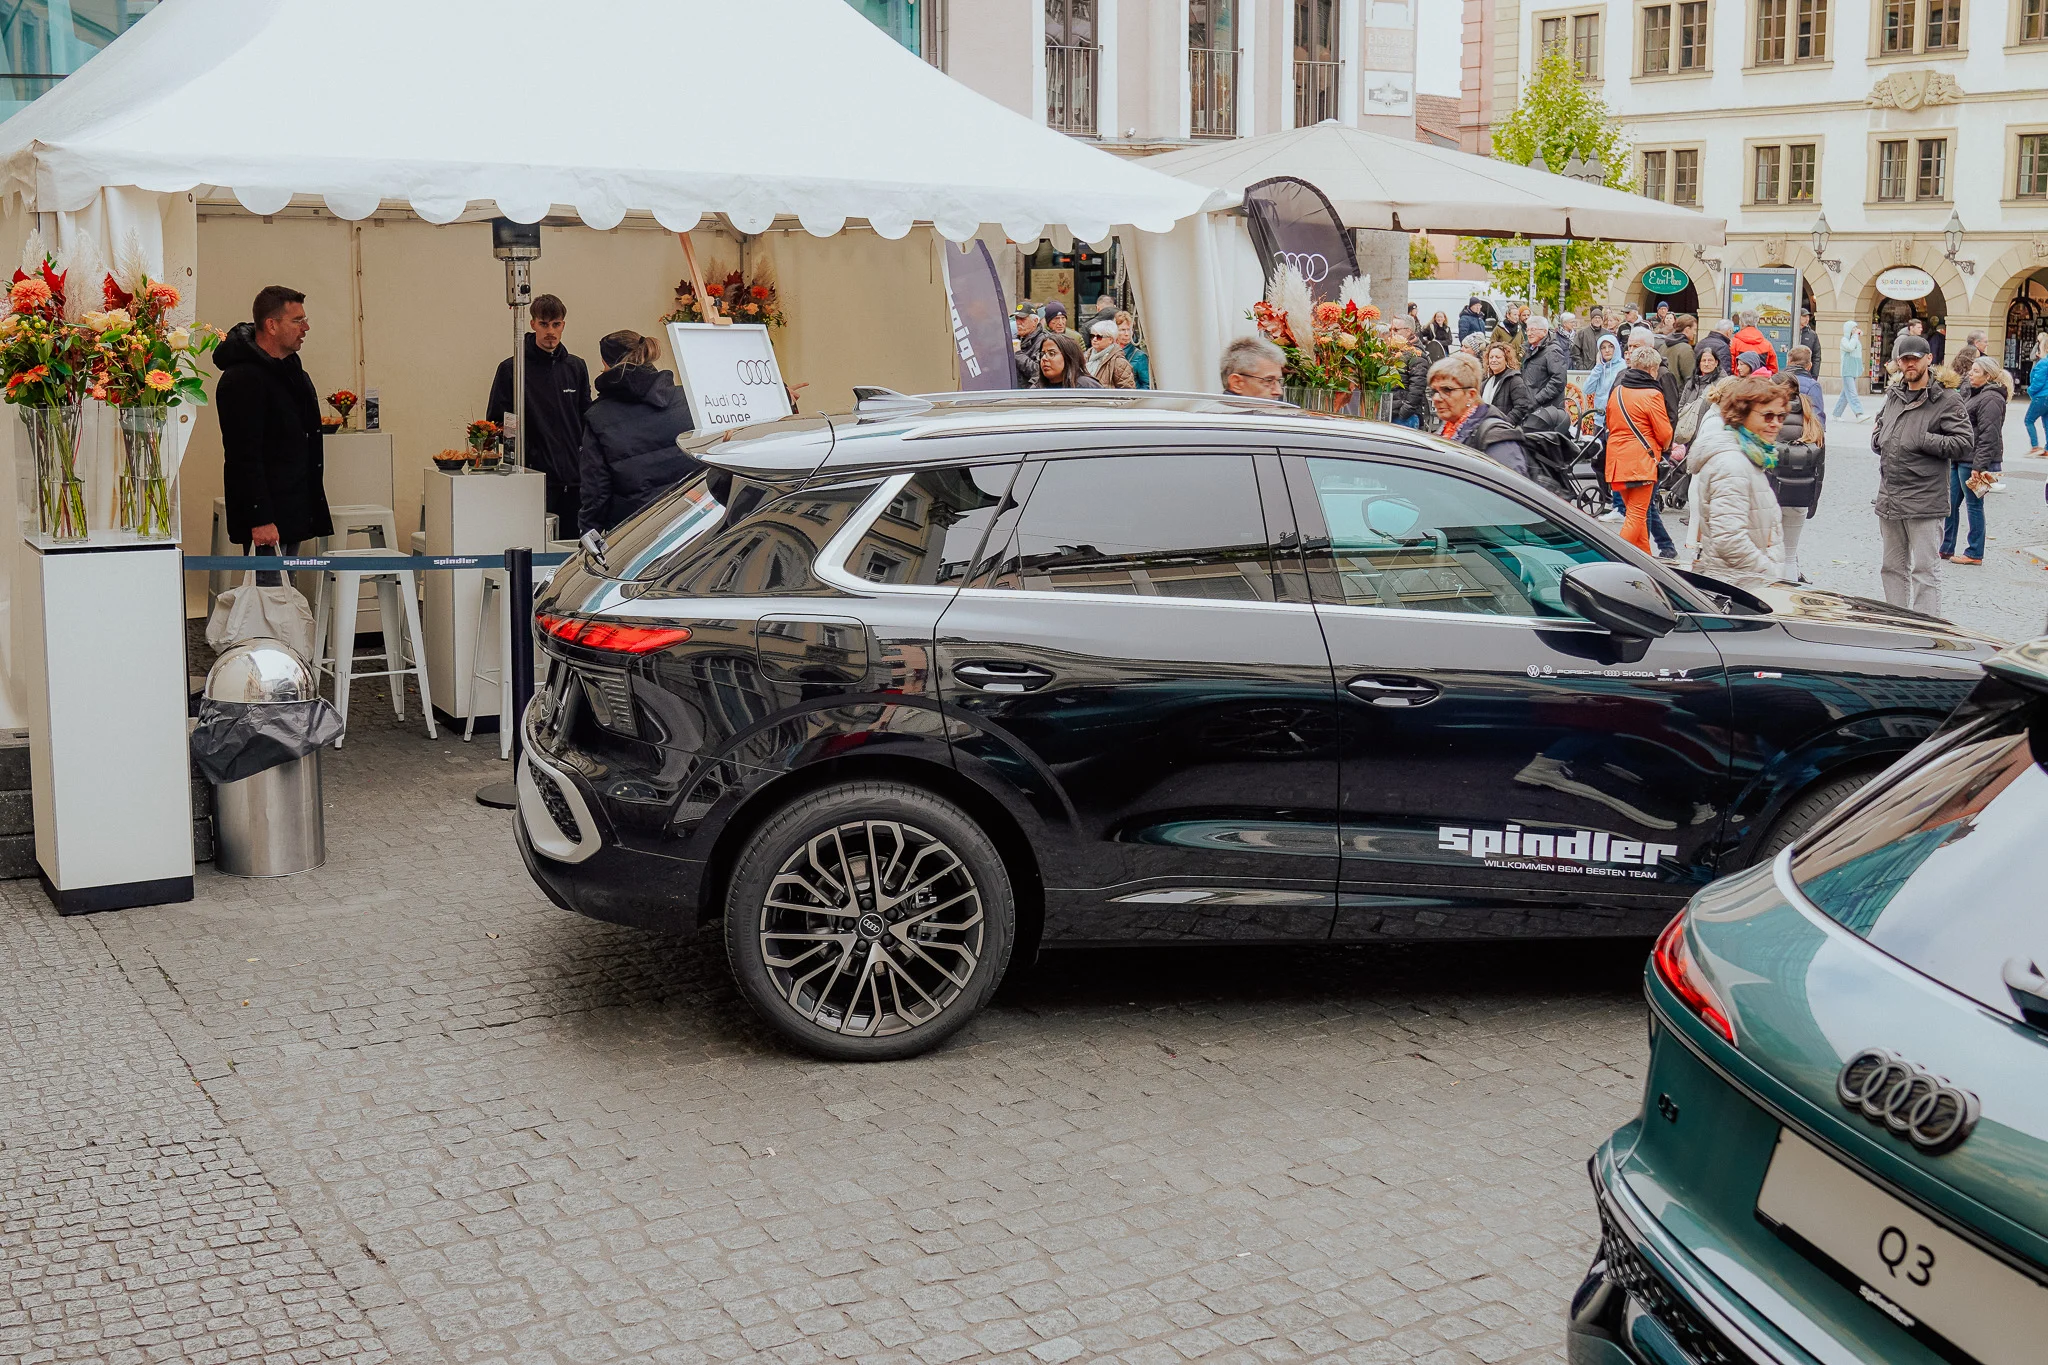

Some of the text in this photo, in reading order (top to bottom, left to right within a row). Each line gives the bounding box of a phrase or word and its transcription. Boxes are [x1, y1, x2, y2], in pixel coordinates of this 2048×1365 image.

[704, 393, 748, 408] Audi Q3
[283, 558, 331, 567] spindler
[433, 557, 479, 567] spindler
[1438, 824, 1678, 865] spindler
[1484, 859, 1657, 879] WILLKOMMEN BEIM BESTEN TEAM
[1658, 1092, 1679, 1124] Q3
[1877, 1225, 1936, 1287] Q3
[1859, 1284, 1915, 1327] spindler
